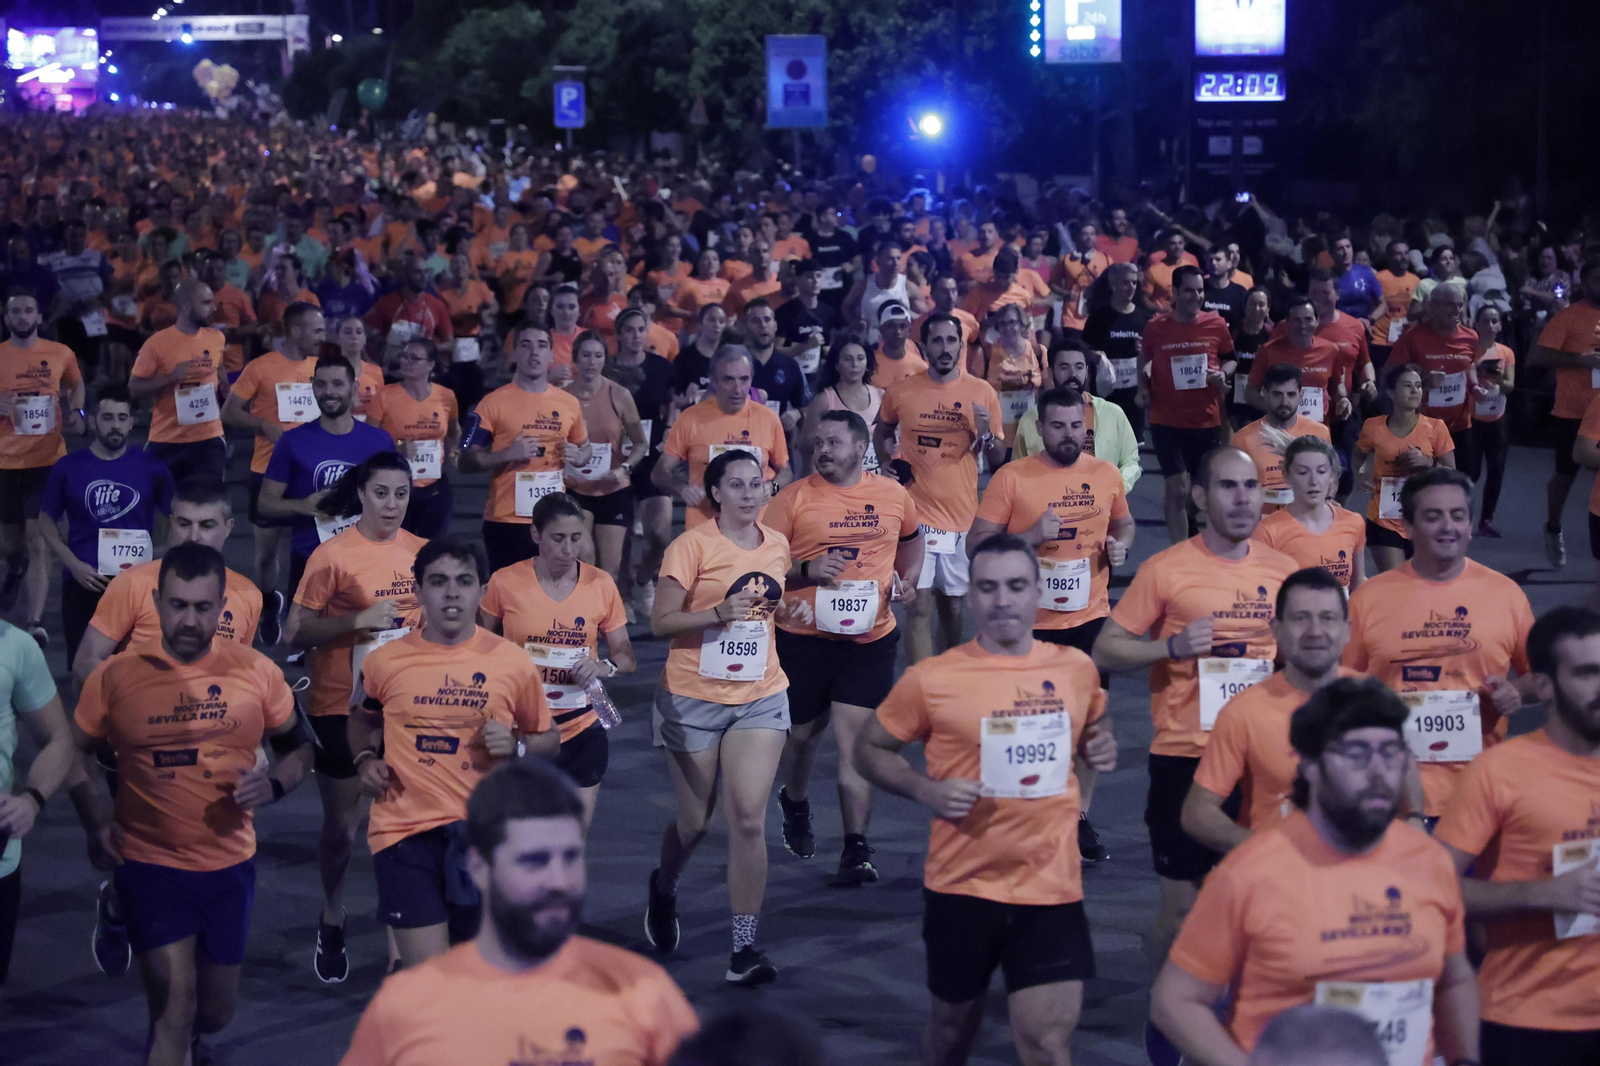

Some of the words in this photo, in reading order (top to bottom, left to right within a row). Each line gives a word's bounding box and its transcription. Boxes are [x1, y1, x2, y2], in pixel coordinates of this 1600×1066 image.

[1200, 73, 1279, 97] 22:09
[1180, 366, 1203, 375] 18047
[190, 399, 210, 409] 4256
[288, 396, 313, 406] 14476
[23, 409, 50, 419] 18546
[1078, 499, 1095, 507] KH7
[861, 520, 879, 528] KH7
[111, 546, 145, 558] 17792
[1045, 577, 1081, 591] 19821
[374, 587, 408, 597] SEVILLA
[830, 598, 868, 612] 19837
[1212, 611, 1251, 619] SEVILLA
[1253, 611, 1272, 619] KH7
[1423, 621, 1472, 629] NOCTURNA
[546, 629, 587, 638] NOCTURNA
[1401, 630, 1444, 639] SEVILLA
[1446, 629, 1470, 638] KH7
[526, 635, 564, 645] SEVILLA
[564, 638, 586, 646] KH7
[719, 640, 758, 656] 18598
[541, 667, 572, 685] 150
[437, 688, 490, 699] NOCTURNA
[173, 701, 228, 713] NOCTURNA
[413, 695, 459, 707] SEVILLA
[461, 698, 488, 710] KH7
[147, 712, 198, 725] SEVILLA
[199, 709, 227, 720] KH7
[1414, 714, 1466, 732] 19903
[1005, 742, 1057, 765] 19992
